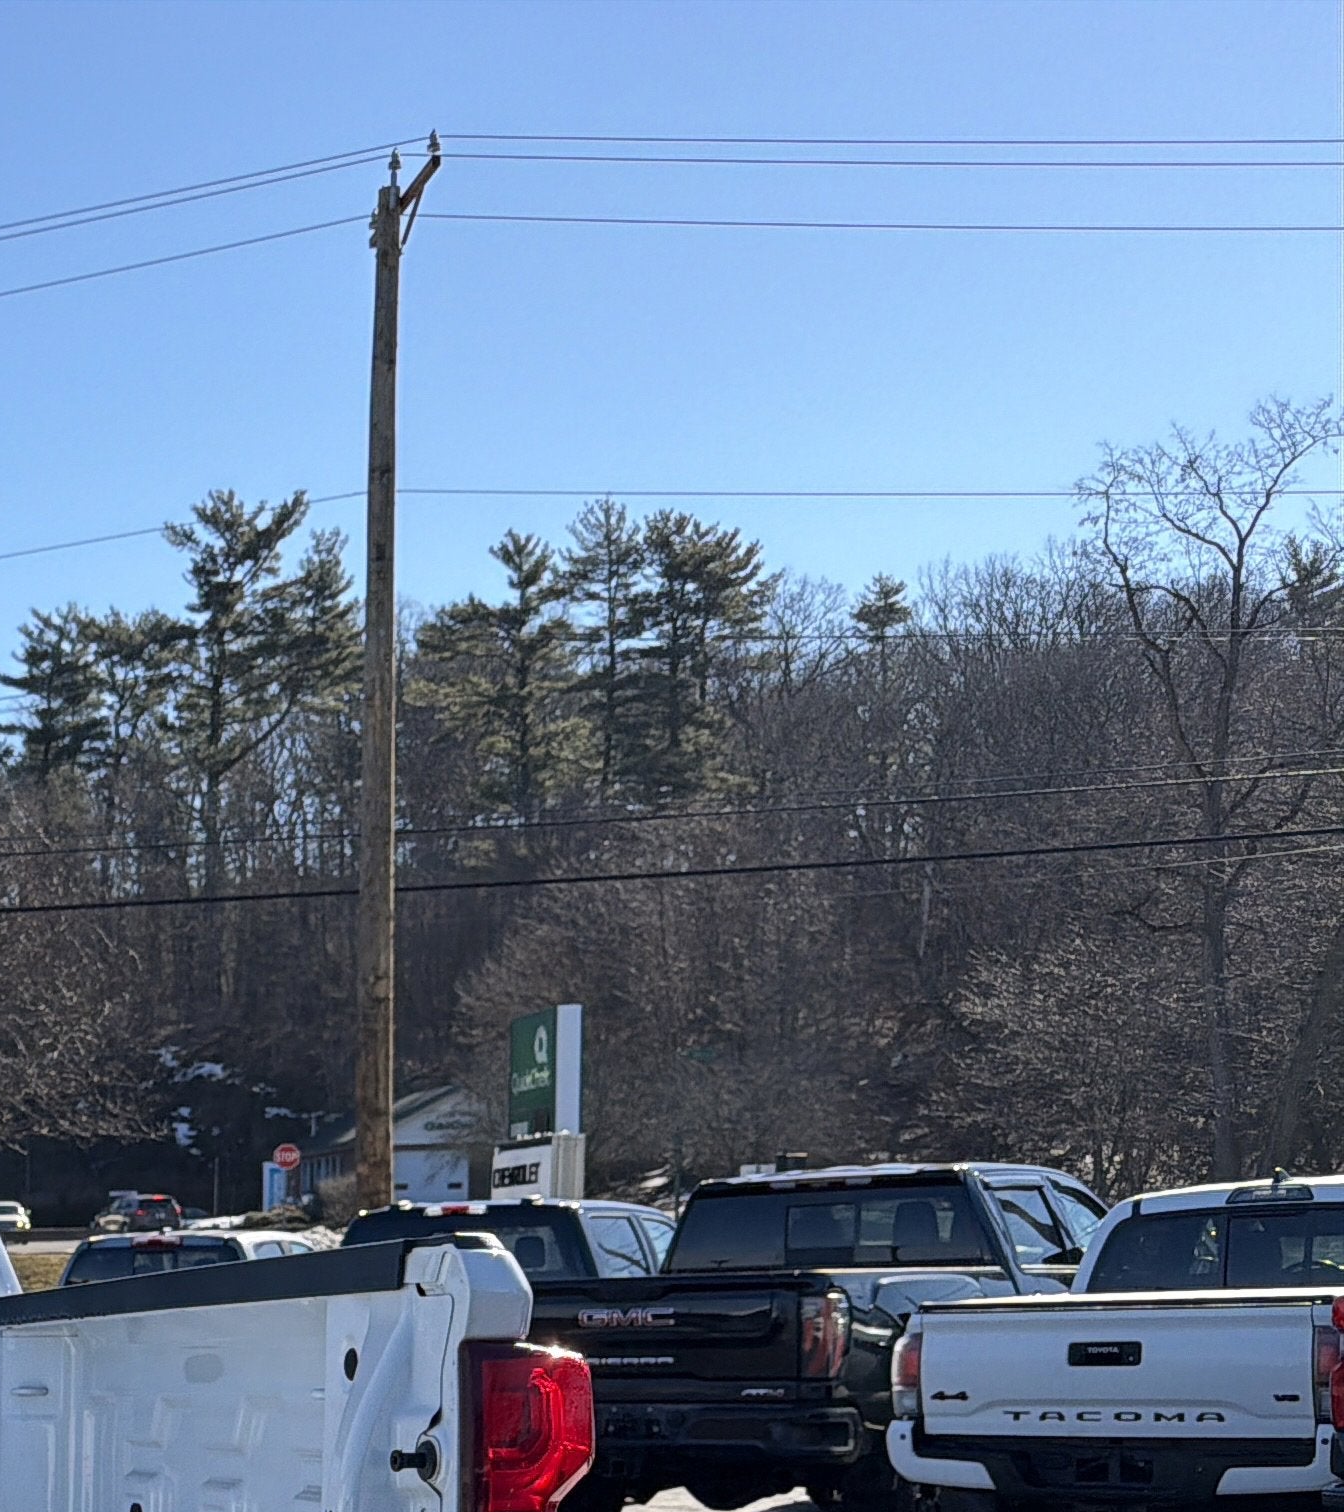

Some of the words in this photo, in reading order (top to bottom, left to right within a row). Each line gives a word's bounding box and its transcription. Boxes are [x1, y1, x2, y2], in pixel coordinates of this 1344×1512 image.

[273, 1150, 299, 1162] STOP
[577, 1307, 675, 1328] GMC
[1087, 1346, 1120, 1354] TOYOTA
[1002, 1410, 1226, 1423] TACOMA
